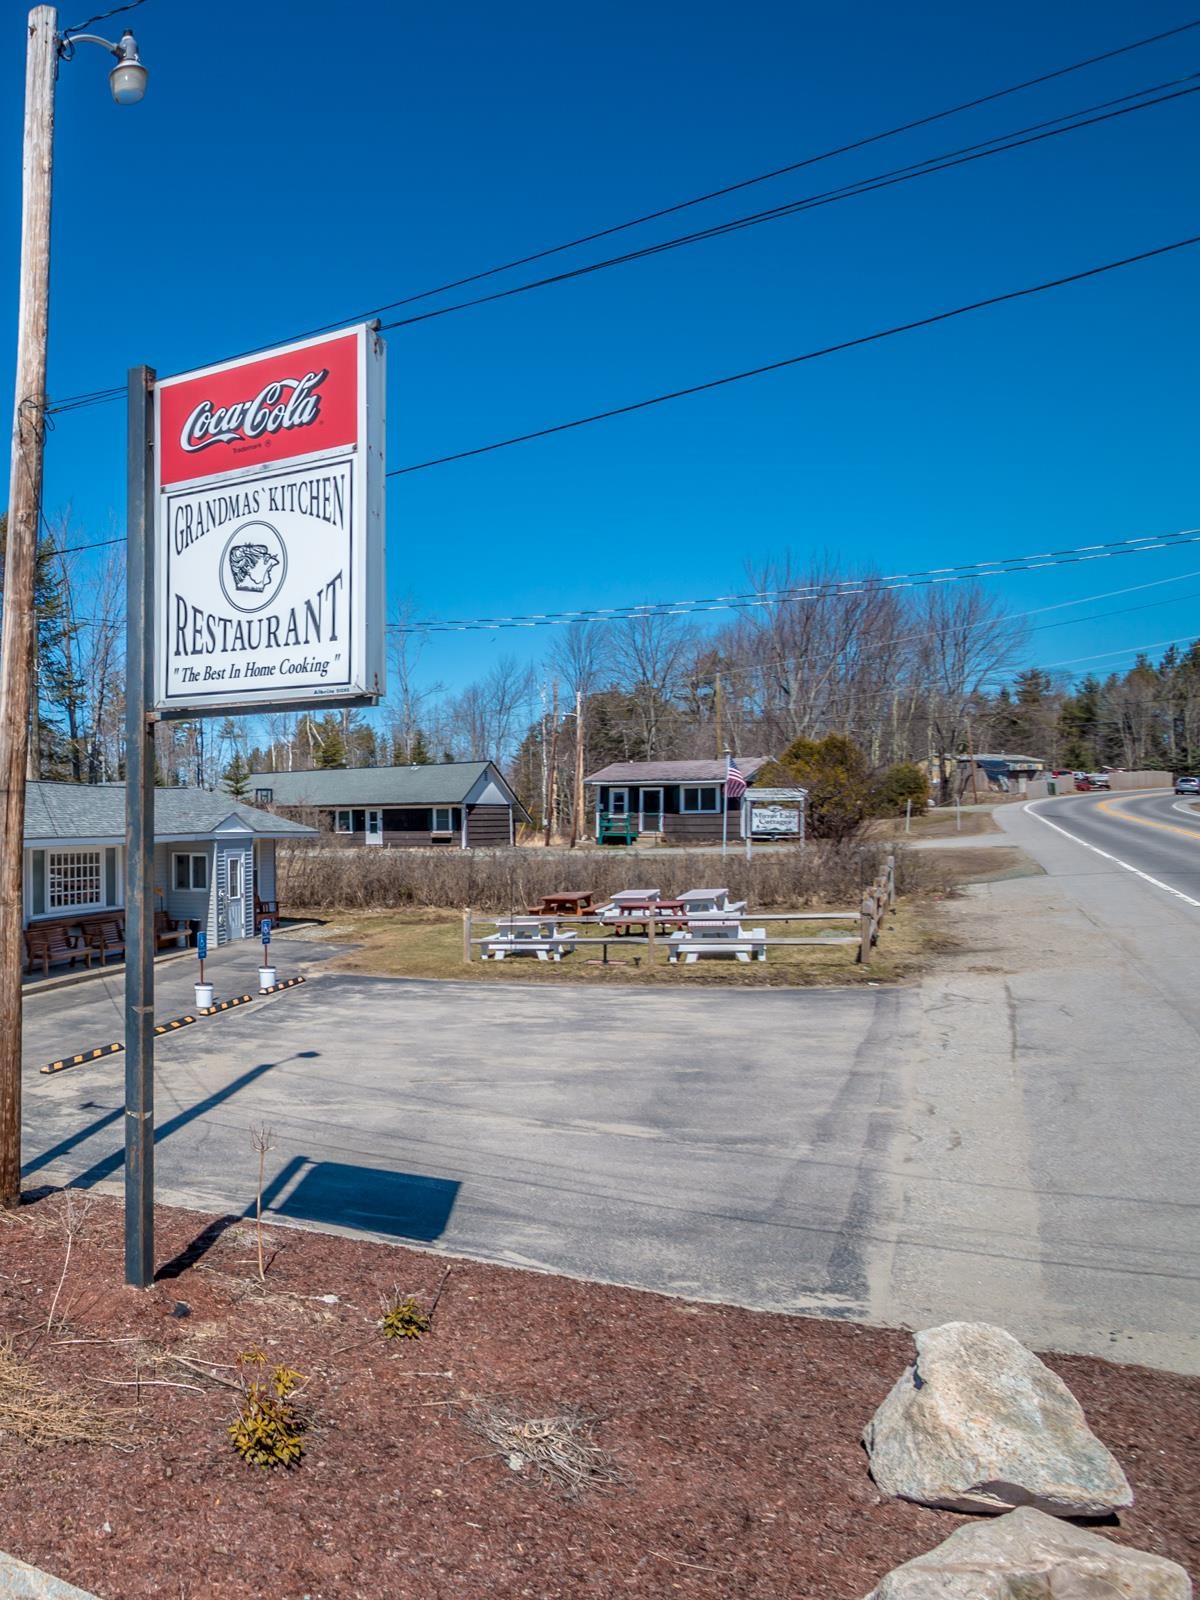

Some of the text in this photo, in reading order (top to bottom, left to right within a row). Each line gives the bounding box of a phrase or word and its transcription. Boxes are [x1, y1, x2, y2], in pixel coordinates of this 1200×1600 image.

[179, 368, 329, 453] Coca-Cola
[268, 473, 346, 530] KITCHEN
[174, 568, 343, 657] RESTAURANT
[203, 664, 226, 681] Best
[229, 663, 241, 679] In
[244, 661, 276, 678] Home
